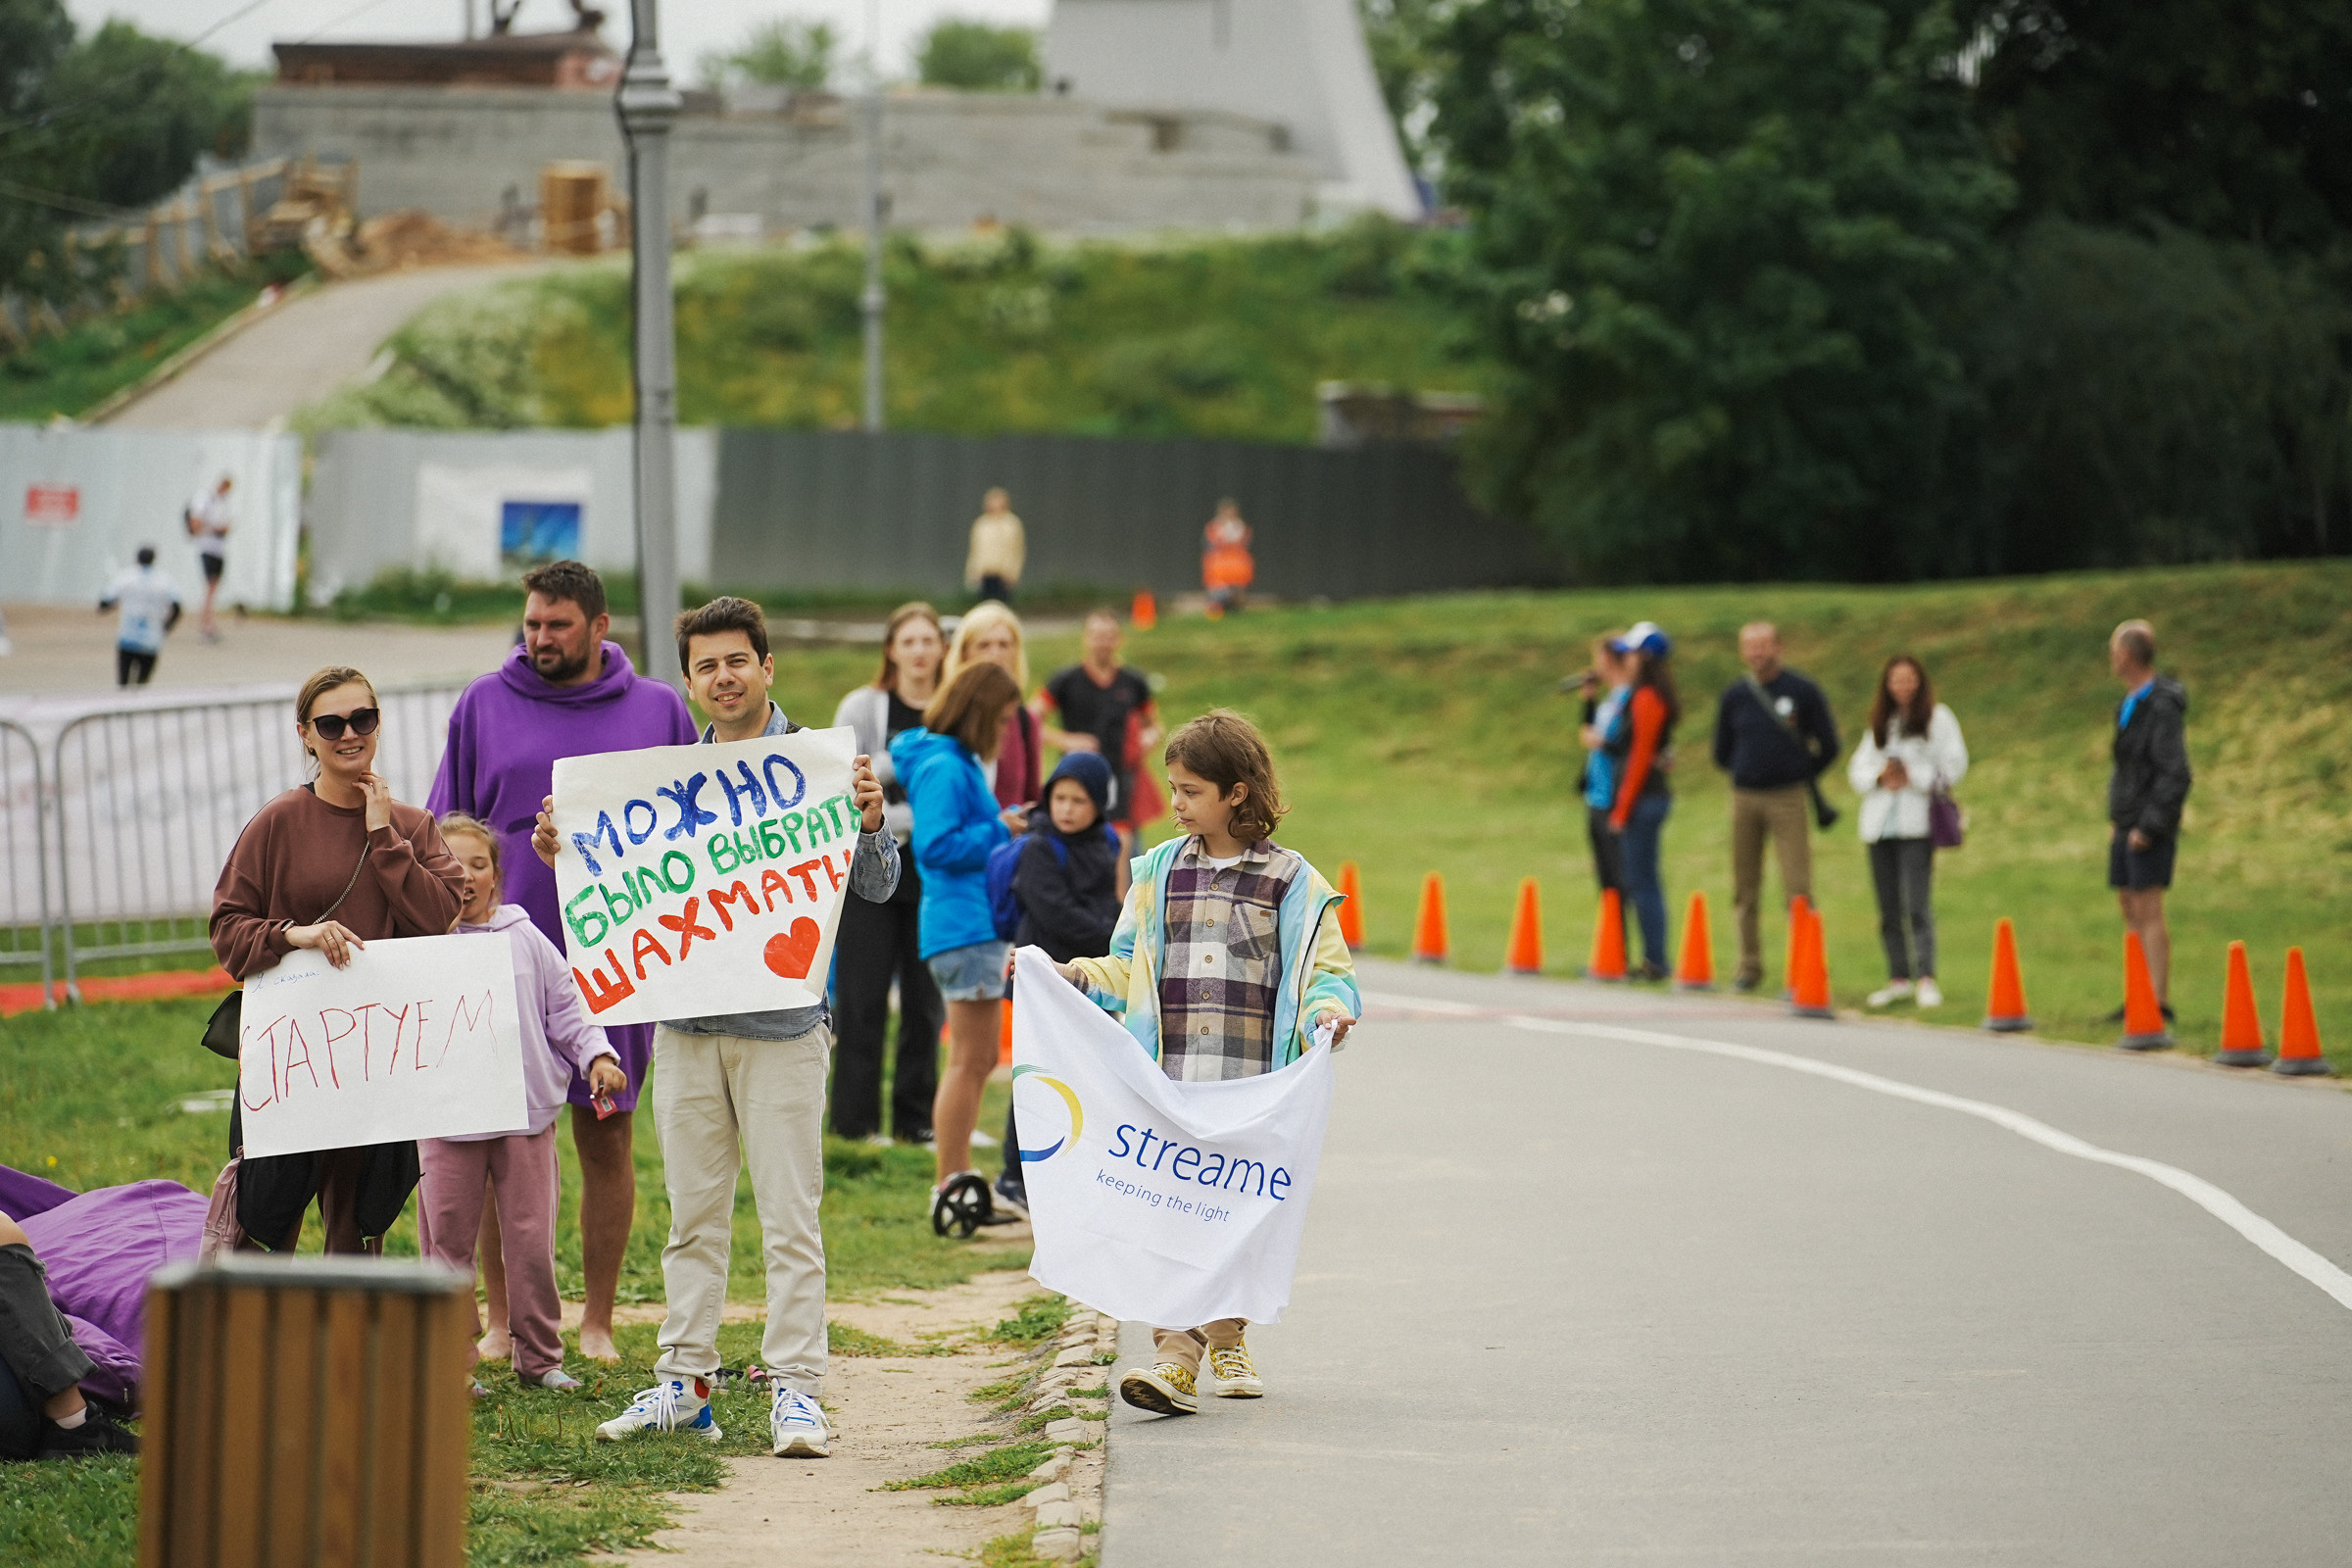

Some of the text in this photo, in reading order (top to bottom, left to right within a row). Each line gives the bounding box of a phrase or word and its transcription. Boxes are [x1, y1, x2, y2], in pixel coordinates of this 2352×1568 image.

[564, 794, 862, 948] БЫЛО ВЫБРАТЬ
[570, 754, 807, 877] МОЖНО
[238, 989, 498, 1112] СТАРТУЕМ
[1096, 1168, 1231, 1222] keeping the light
